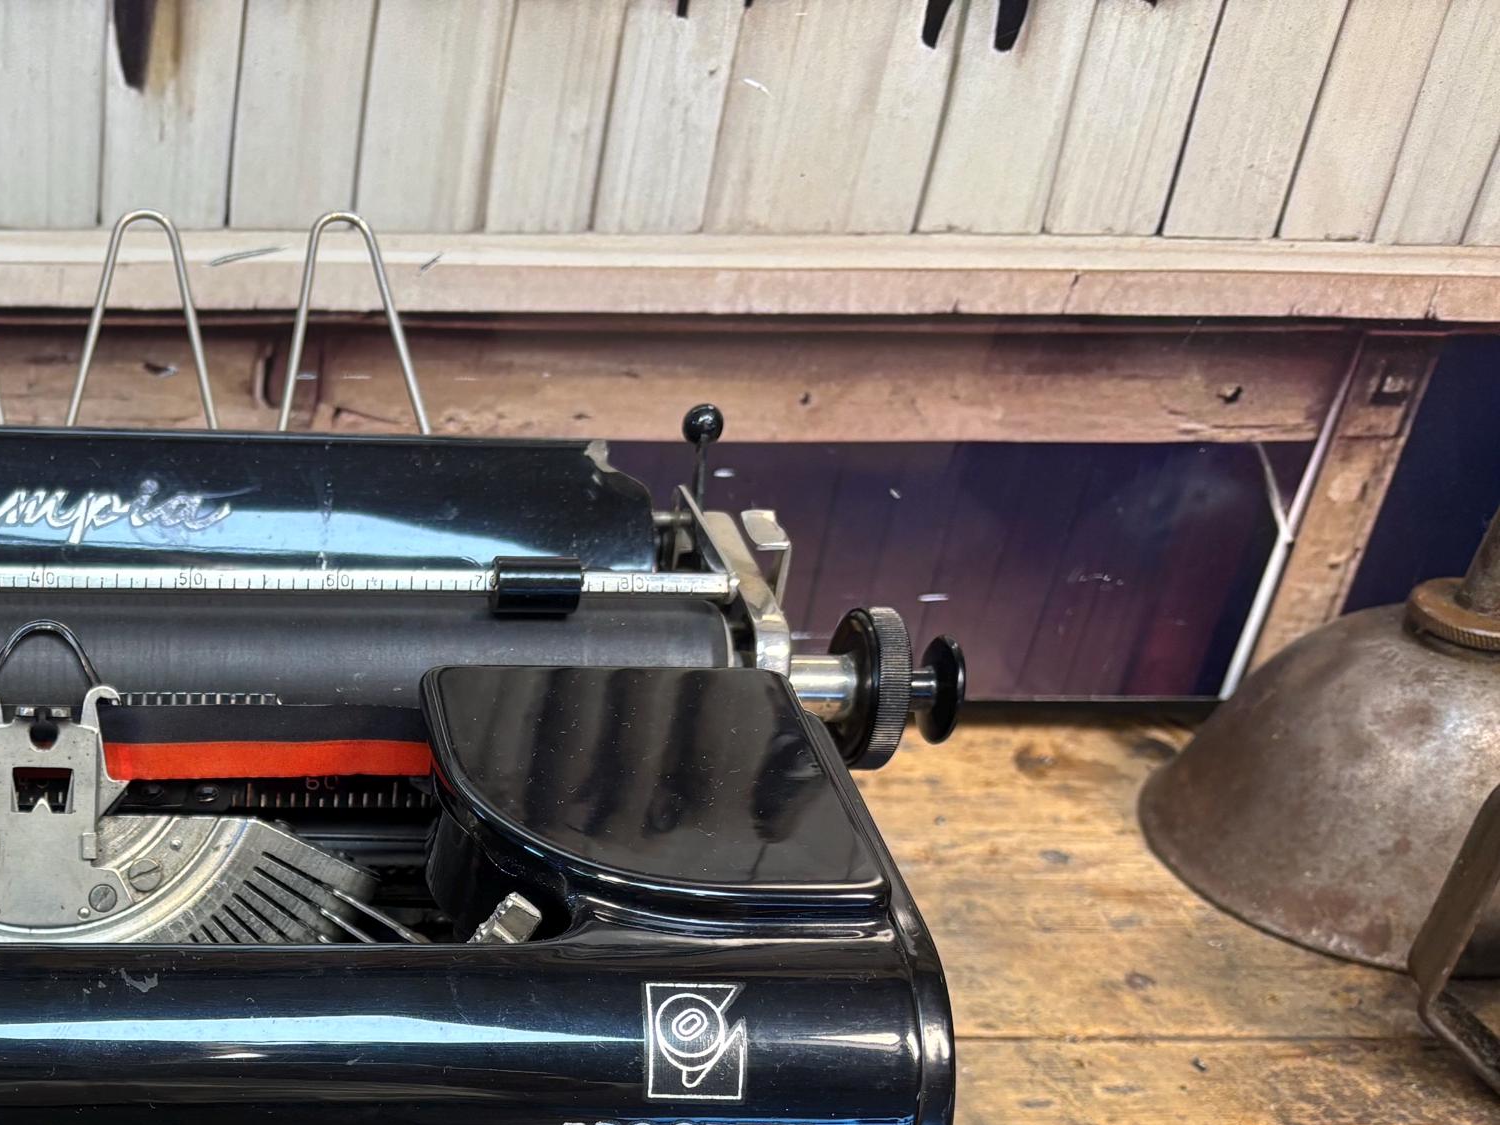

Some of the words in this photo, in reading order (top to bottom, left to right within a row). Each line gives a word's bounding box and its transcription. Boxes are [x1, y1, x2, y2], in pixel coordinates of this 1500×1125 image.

[31, 569, 55, 585] 40
[179, 569, 203, 585] 50
[326, 571, 349, 589] 60
